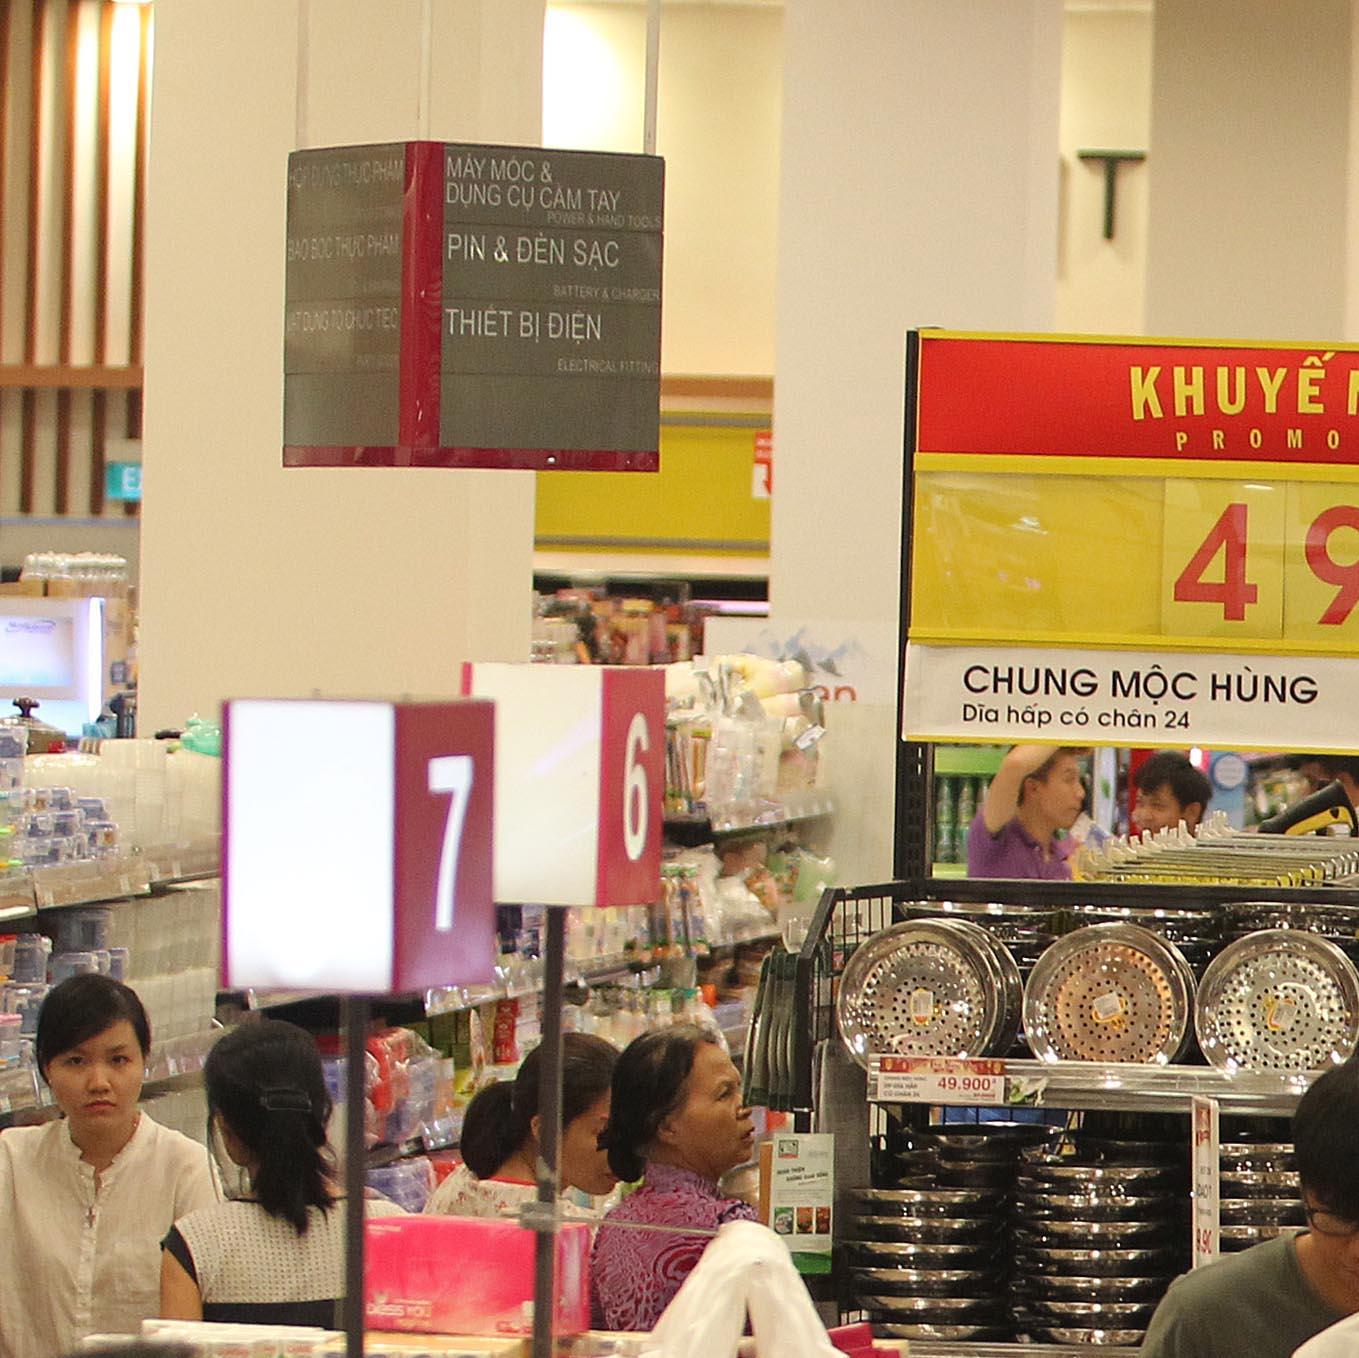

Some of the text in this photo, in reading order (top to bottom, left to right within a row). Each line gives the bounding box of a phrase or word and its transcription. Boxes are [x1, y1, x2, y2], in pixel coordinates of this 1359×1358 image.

[446, 152, 553, 184] MÁY MÓC &
[446, 182, 501, 208] DỤNG
[507, 185, 534, 212] CỤ
[588, 188, 621, 212] TAY
[547, 211, 585, 225] POWER
[596, 213, 625, 227] HAND
[446, 232, 620, 271] PIN & ĐÈN SẠC
[553, 284, 598, 298] BATTERY
[445, 303, 602, 345] THIẾT BỊ ĐIỆN
[557, 358, 616, 373] ELECTRICAL
[962, 663, 1319, 706] CHUNG MỘC HÙNG
[1007, 702, 1052, 729] hấp
[1060, 704, 1090, 726] có
[1098, 708, 1157, 729] chân
[1164, 710, 1191, 729] 24
[621, 711, 650, 864] 6
[426, 753, 476, 933] 7
